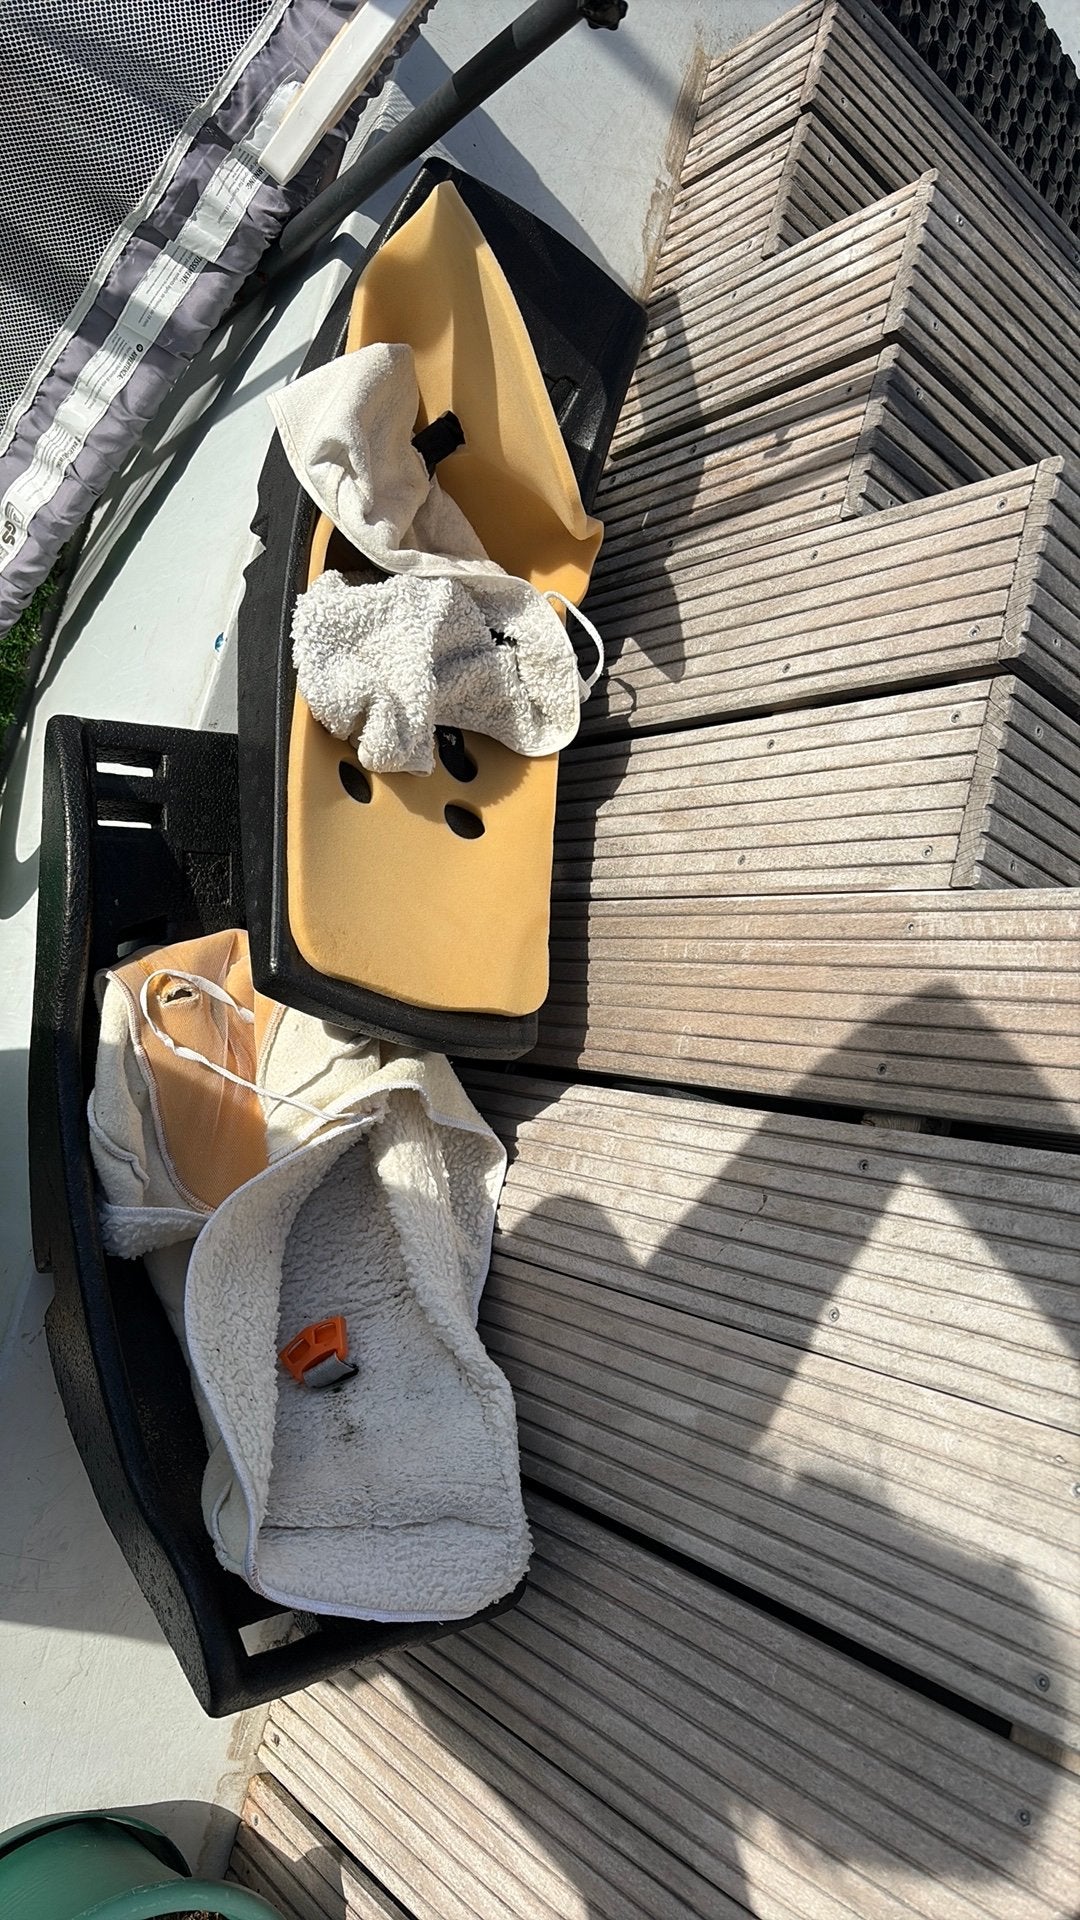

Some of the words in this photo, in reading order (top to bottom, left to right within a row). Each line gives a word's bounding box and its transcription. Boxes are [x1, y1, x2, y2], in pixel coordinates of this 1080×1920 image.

[244, 165, 265, 191] ARNUNG:
[178, 254, 202, 285] TISSEMENT:
[1, 519, 16, 546] GS
